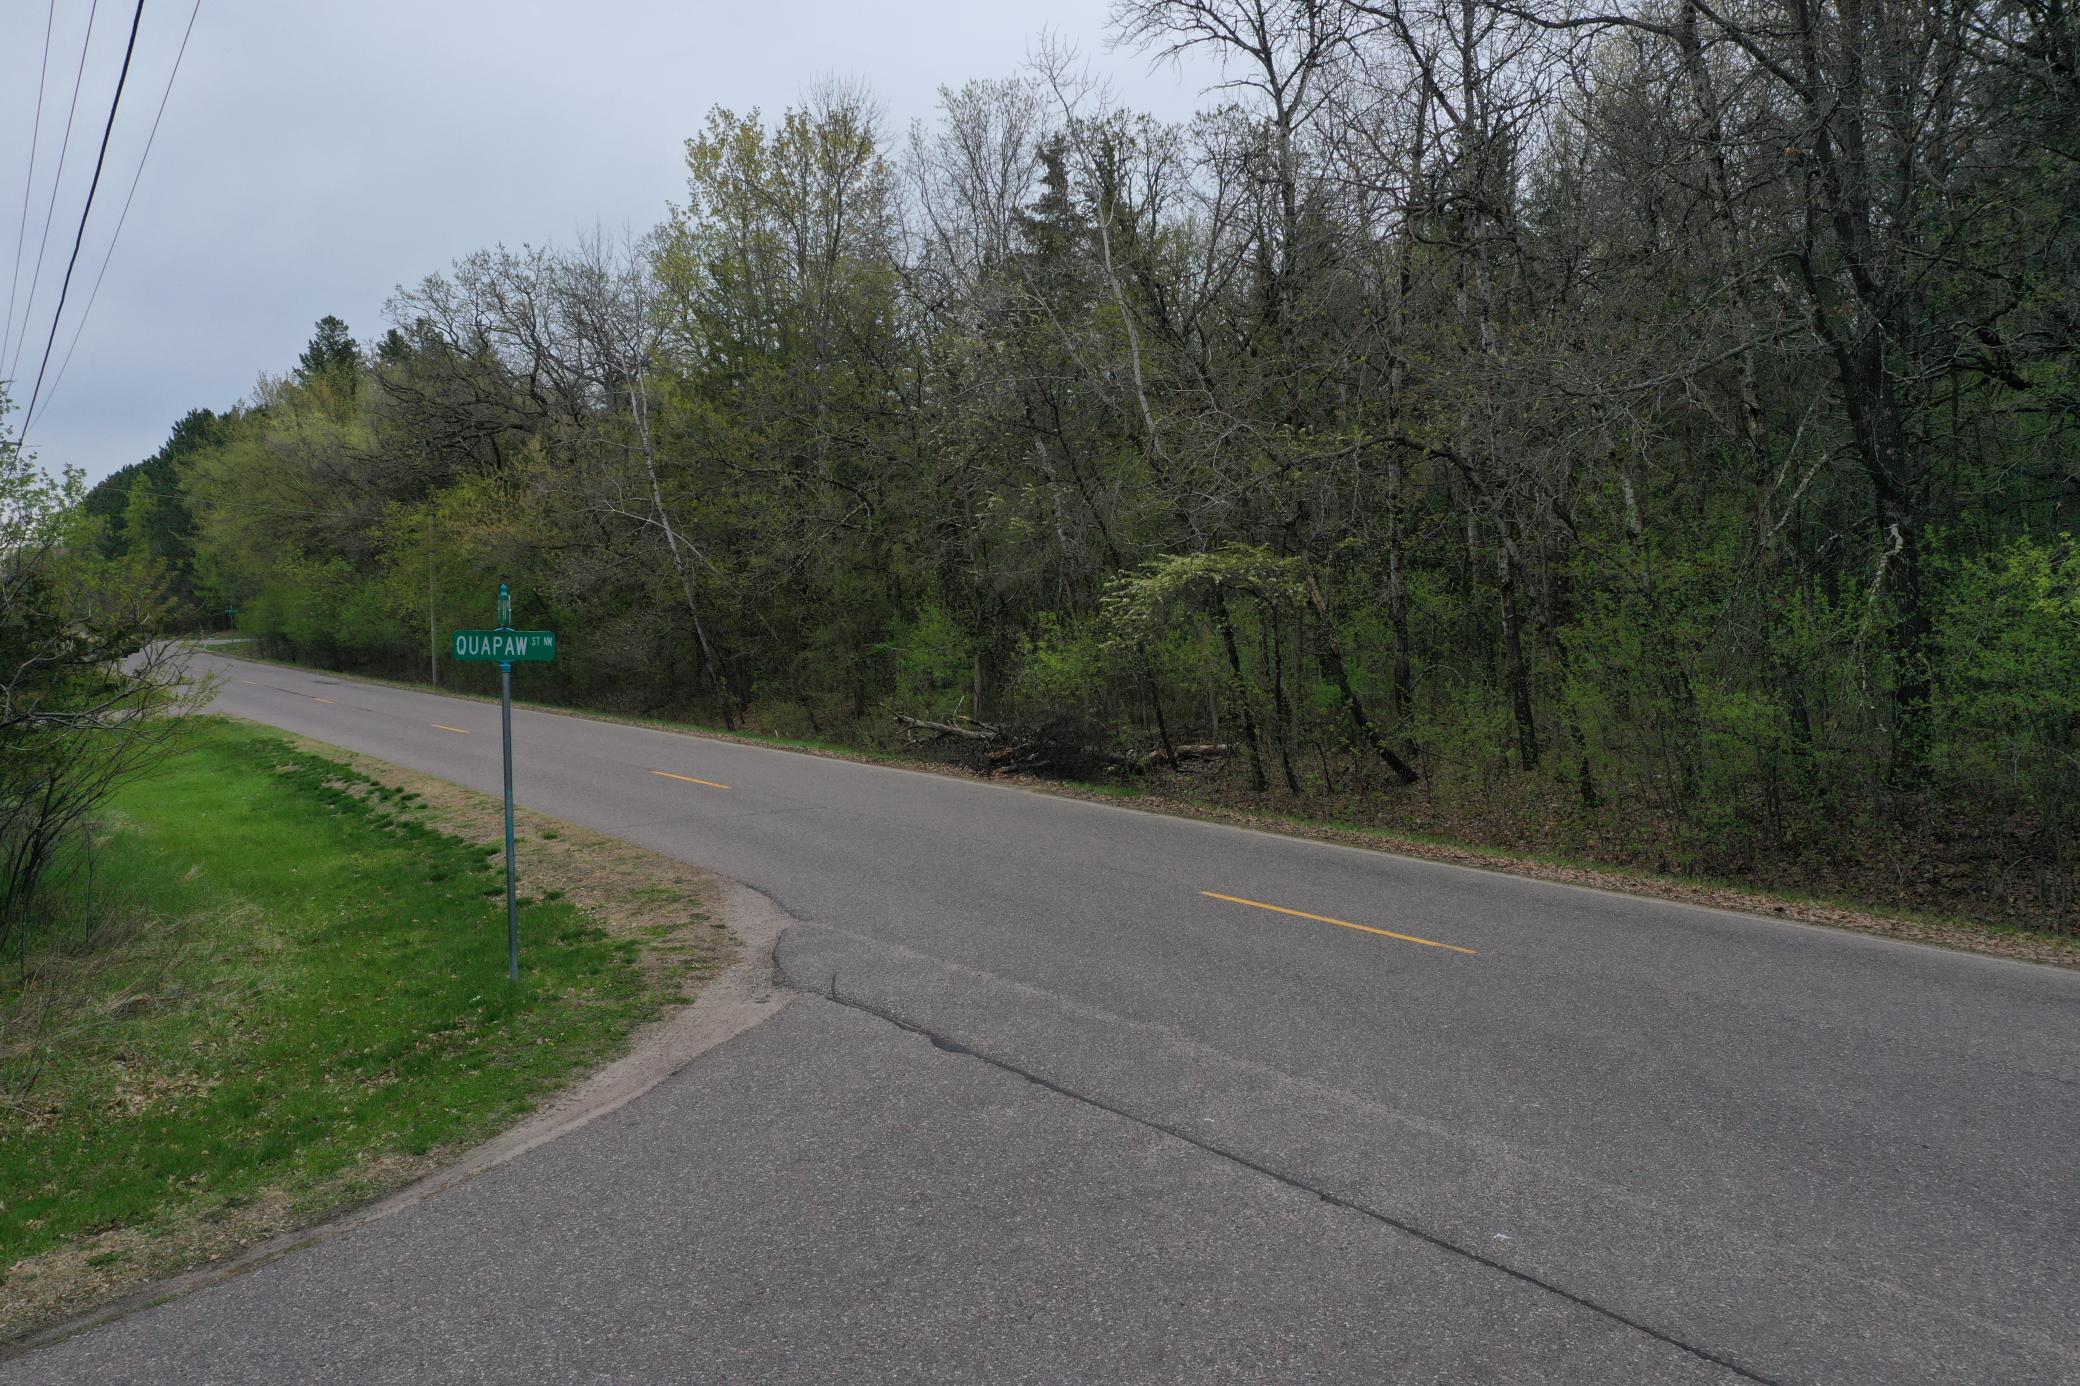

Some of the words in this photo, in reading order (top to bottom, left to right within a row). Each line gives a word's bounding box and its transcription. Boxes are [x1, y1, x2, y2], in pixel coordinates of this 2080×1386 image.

[456, 635, 528, 656] QUAPAW
[531, 636, 541, 646] ST
[543, 636, 553, 647] NW
